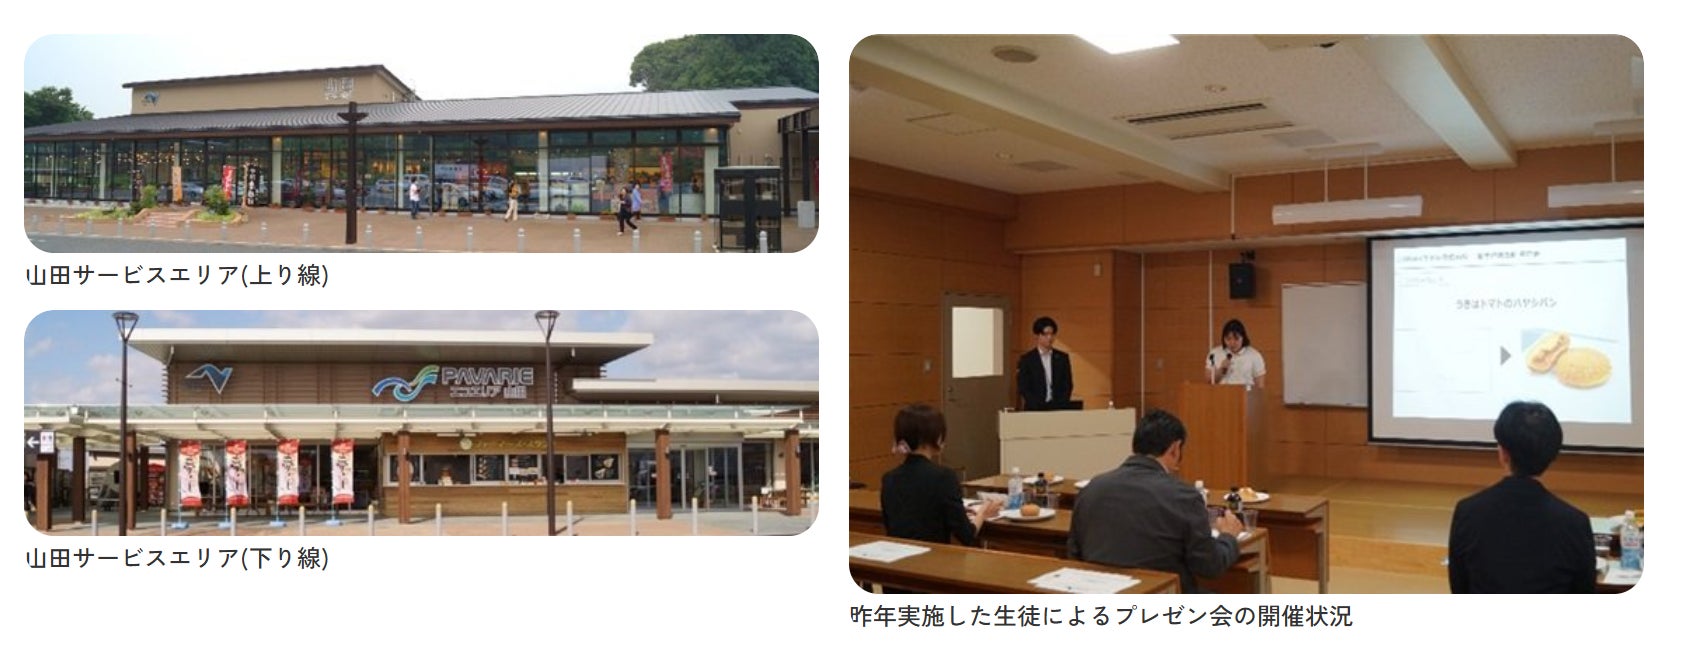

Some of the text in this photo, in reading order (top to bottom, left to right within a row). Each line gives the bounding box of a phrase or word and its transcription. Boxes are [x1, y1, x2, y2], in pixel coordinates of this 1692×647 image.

[442, 366, 534, 386] PAVARIE
[450, 386, 502, 398] エコエリア
